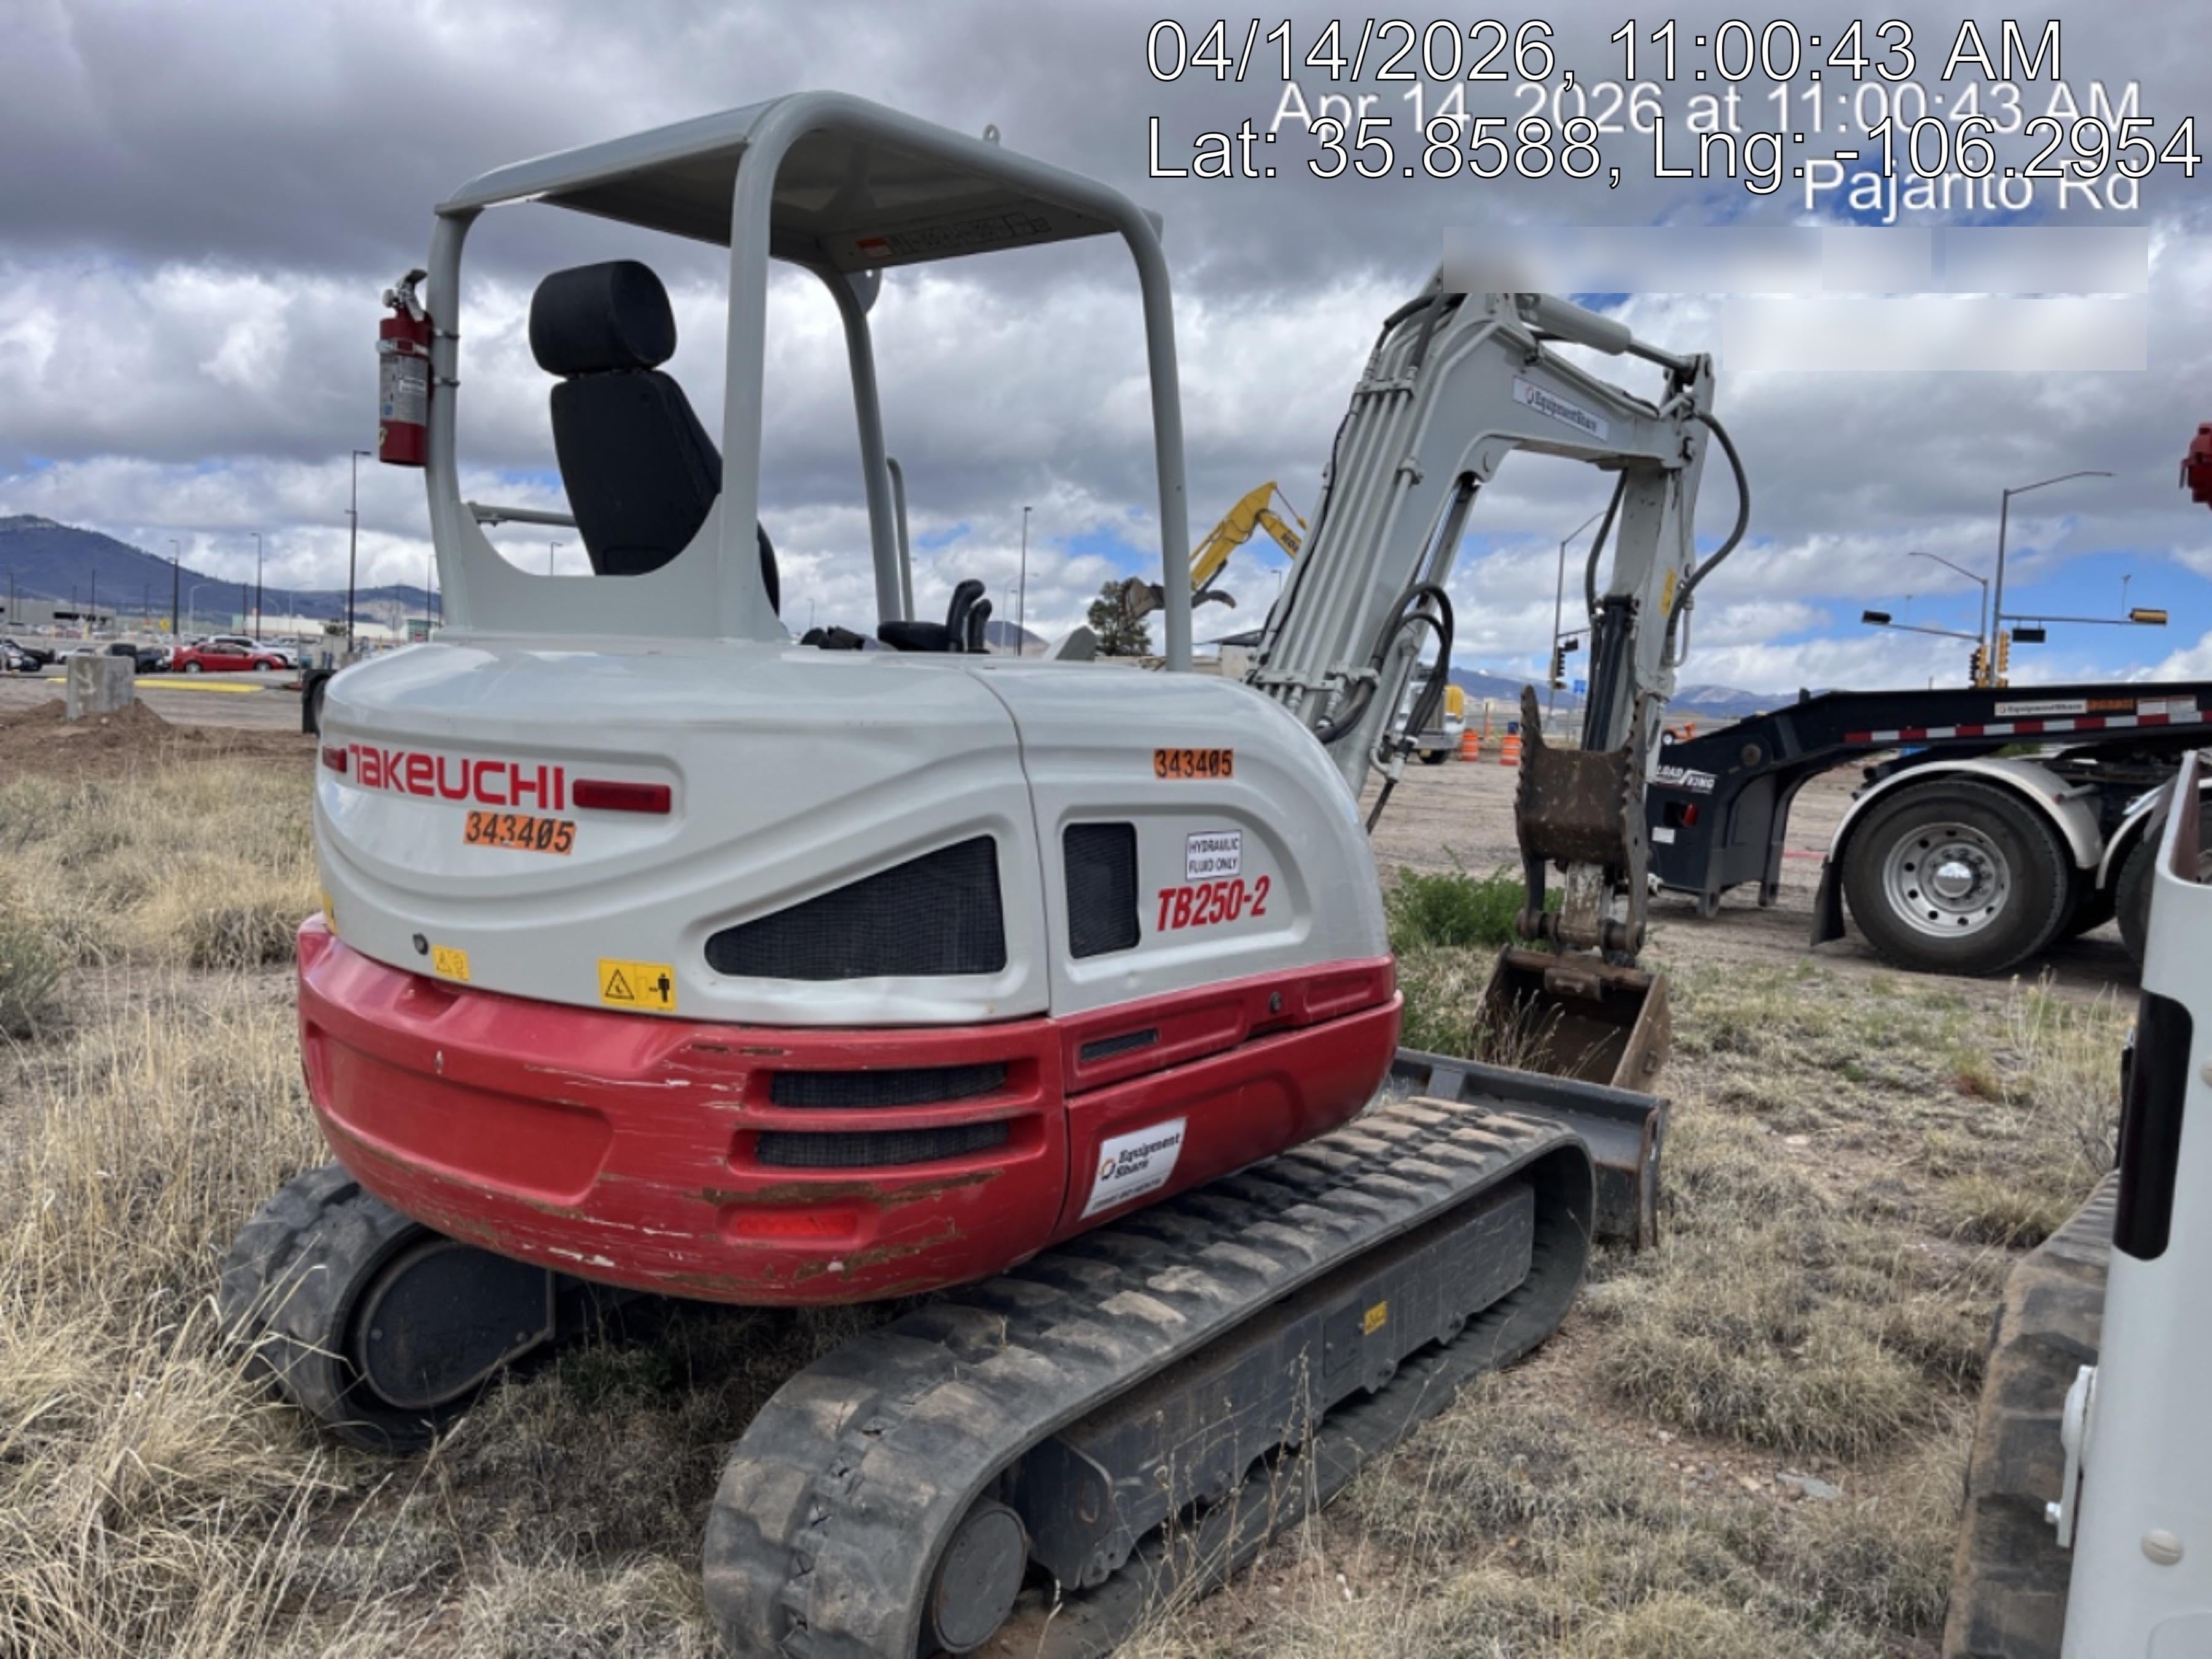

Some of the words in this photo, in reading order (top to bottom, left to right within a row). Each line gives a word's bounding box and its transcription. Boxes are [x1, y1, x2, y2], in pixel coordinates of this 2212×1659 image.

[1155, 749, 1233, 779] 343405
[466, 810, 576, 852] 343405
[1188, 838, 1239, 854] HYDRAULIC
[1188, 858, 1214, 874] FLUID
[1217, 857, 1237, 871] ONLY
[1157, 876, 1270, 931] TB250-2
[1118, 1132, 1180, 1164] Equipment
[1115, 1159, 1149, 1179] Share
